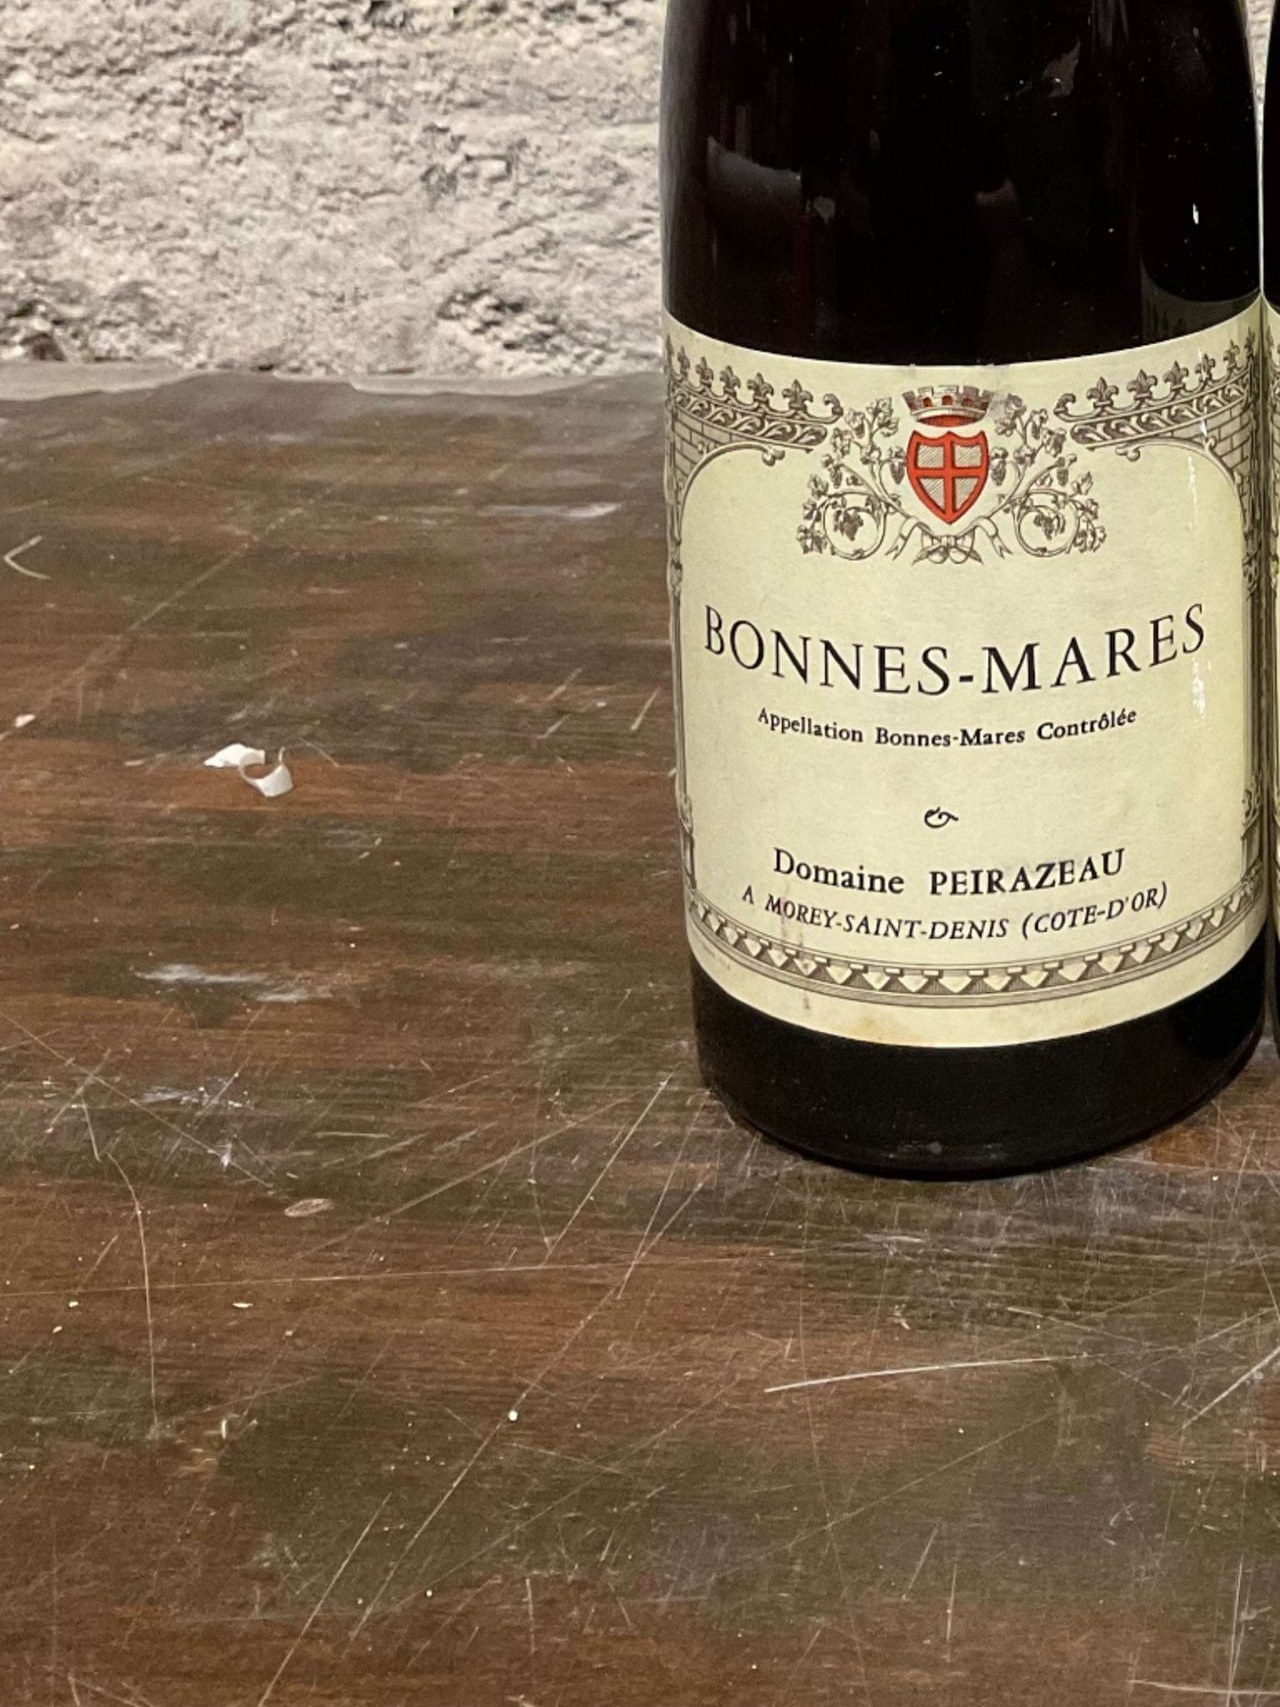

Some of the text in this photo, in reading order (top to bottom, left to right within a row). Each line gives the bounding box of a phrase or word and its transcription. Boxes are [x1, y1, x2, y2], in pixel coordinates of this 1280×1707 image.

[703, 602, 1207, 697] BONNES-MARES
[757, 706, 1138, 748] Appellation Bonnes-Mares Contrôlée
[772, 846, 1127, 897] Domaine PEIRAZEAU
[741, 880, 1169, 941] A MOREY-SAINT-DENIS (COTE-D'OR)
